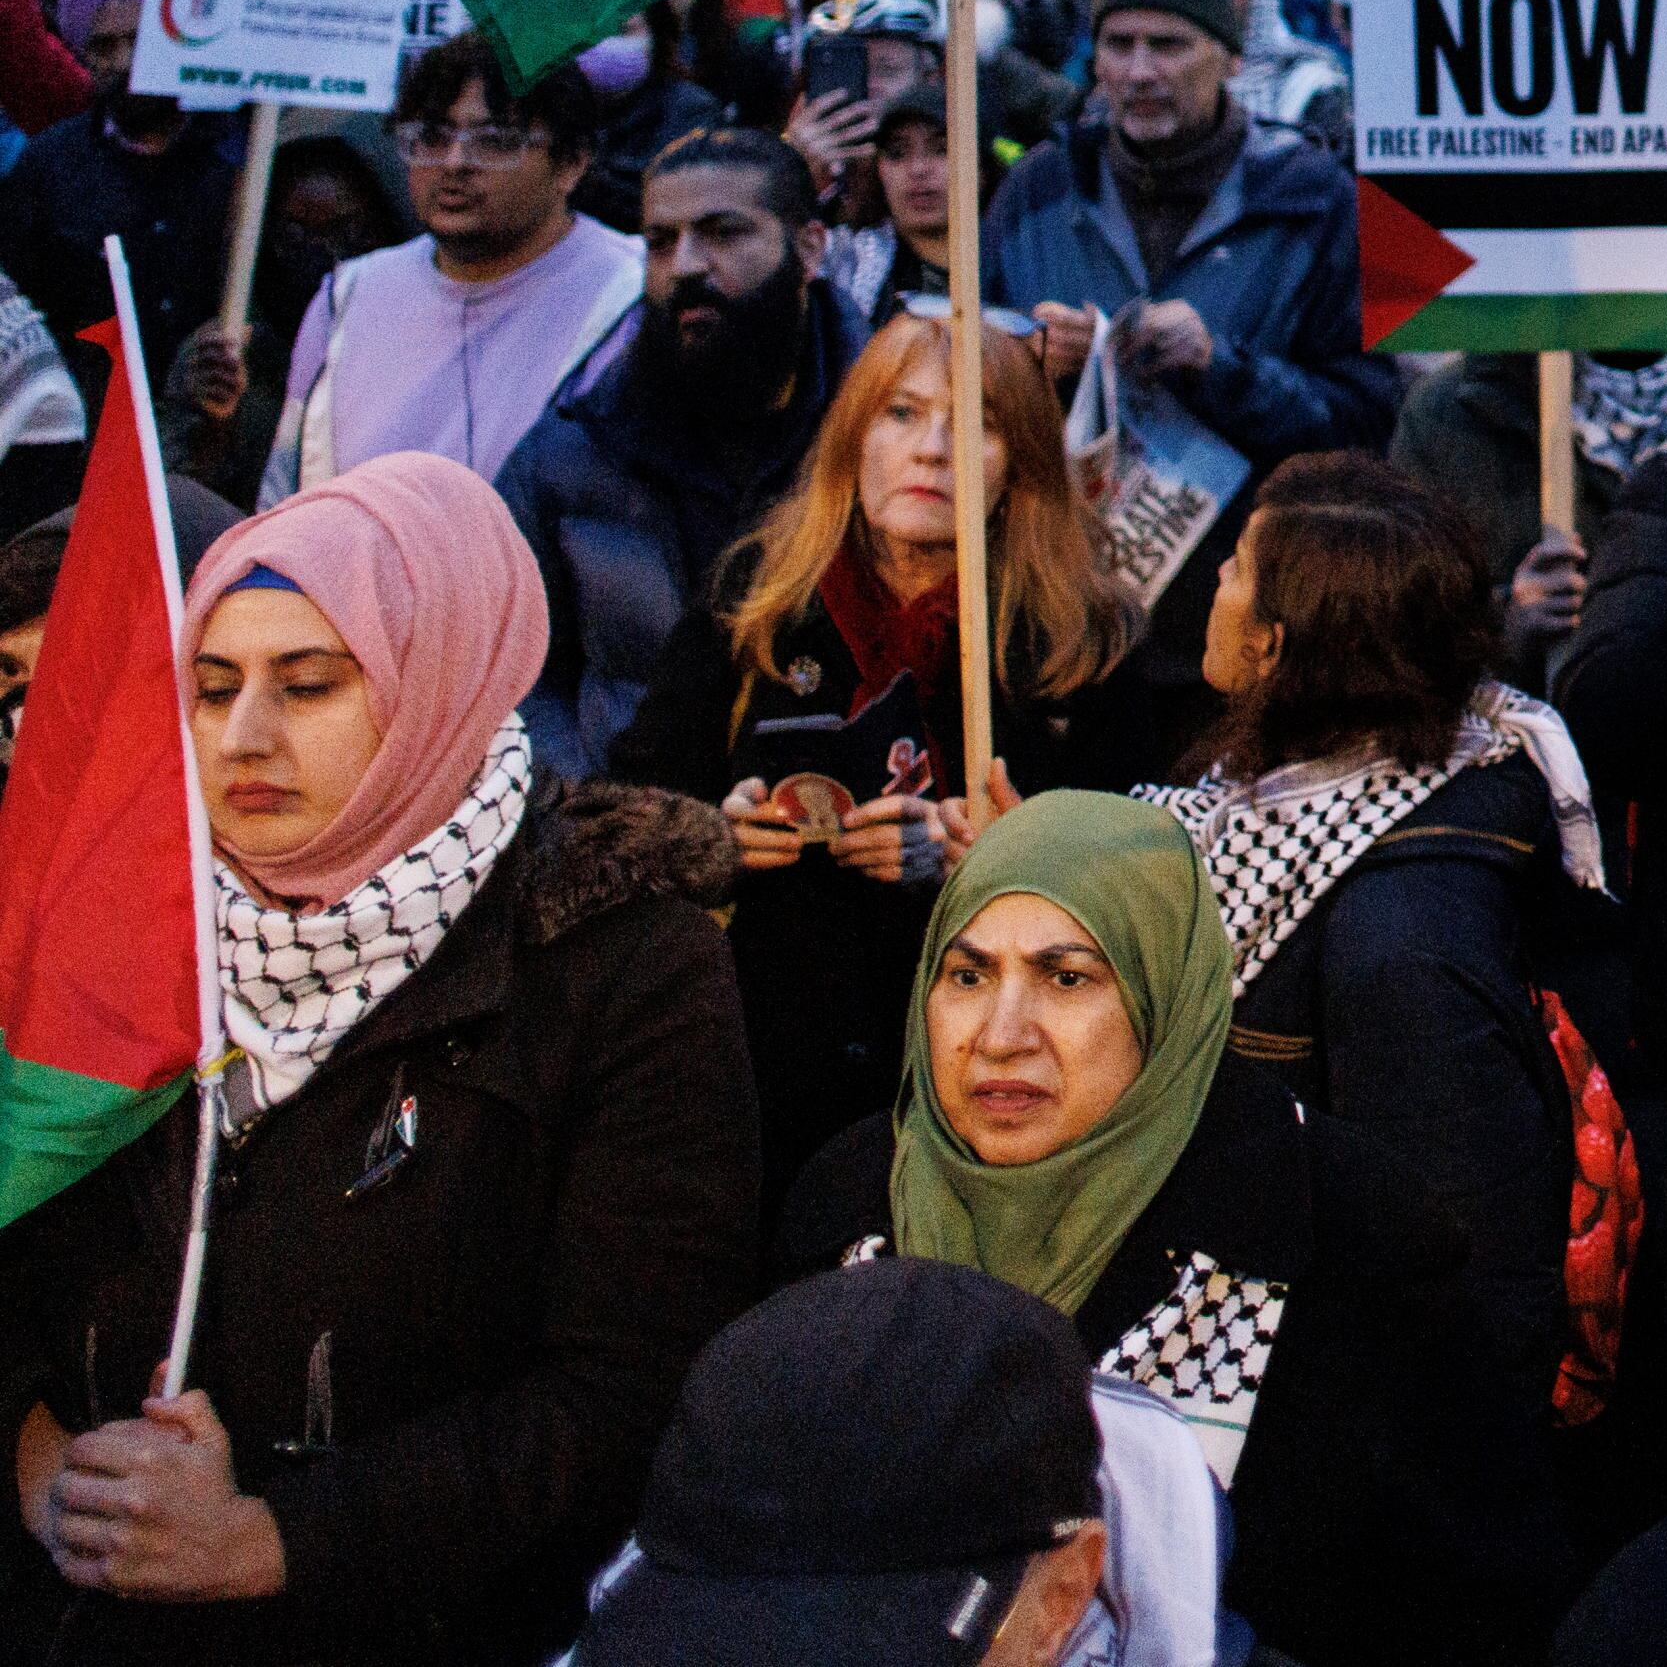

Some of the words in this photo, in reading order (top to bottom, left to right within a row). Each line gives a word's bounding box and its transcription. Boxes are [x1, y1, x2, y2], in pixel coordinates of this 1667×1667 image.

[1367, 128, 1421, 158] FREE
[1428, 127, 1547, 158] PALESTINE
[1571, 126, 1616, 157] END
